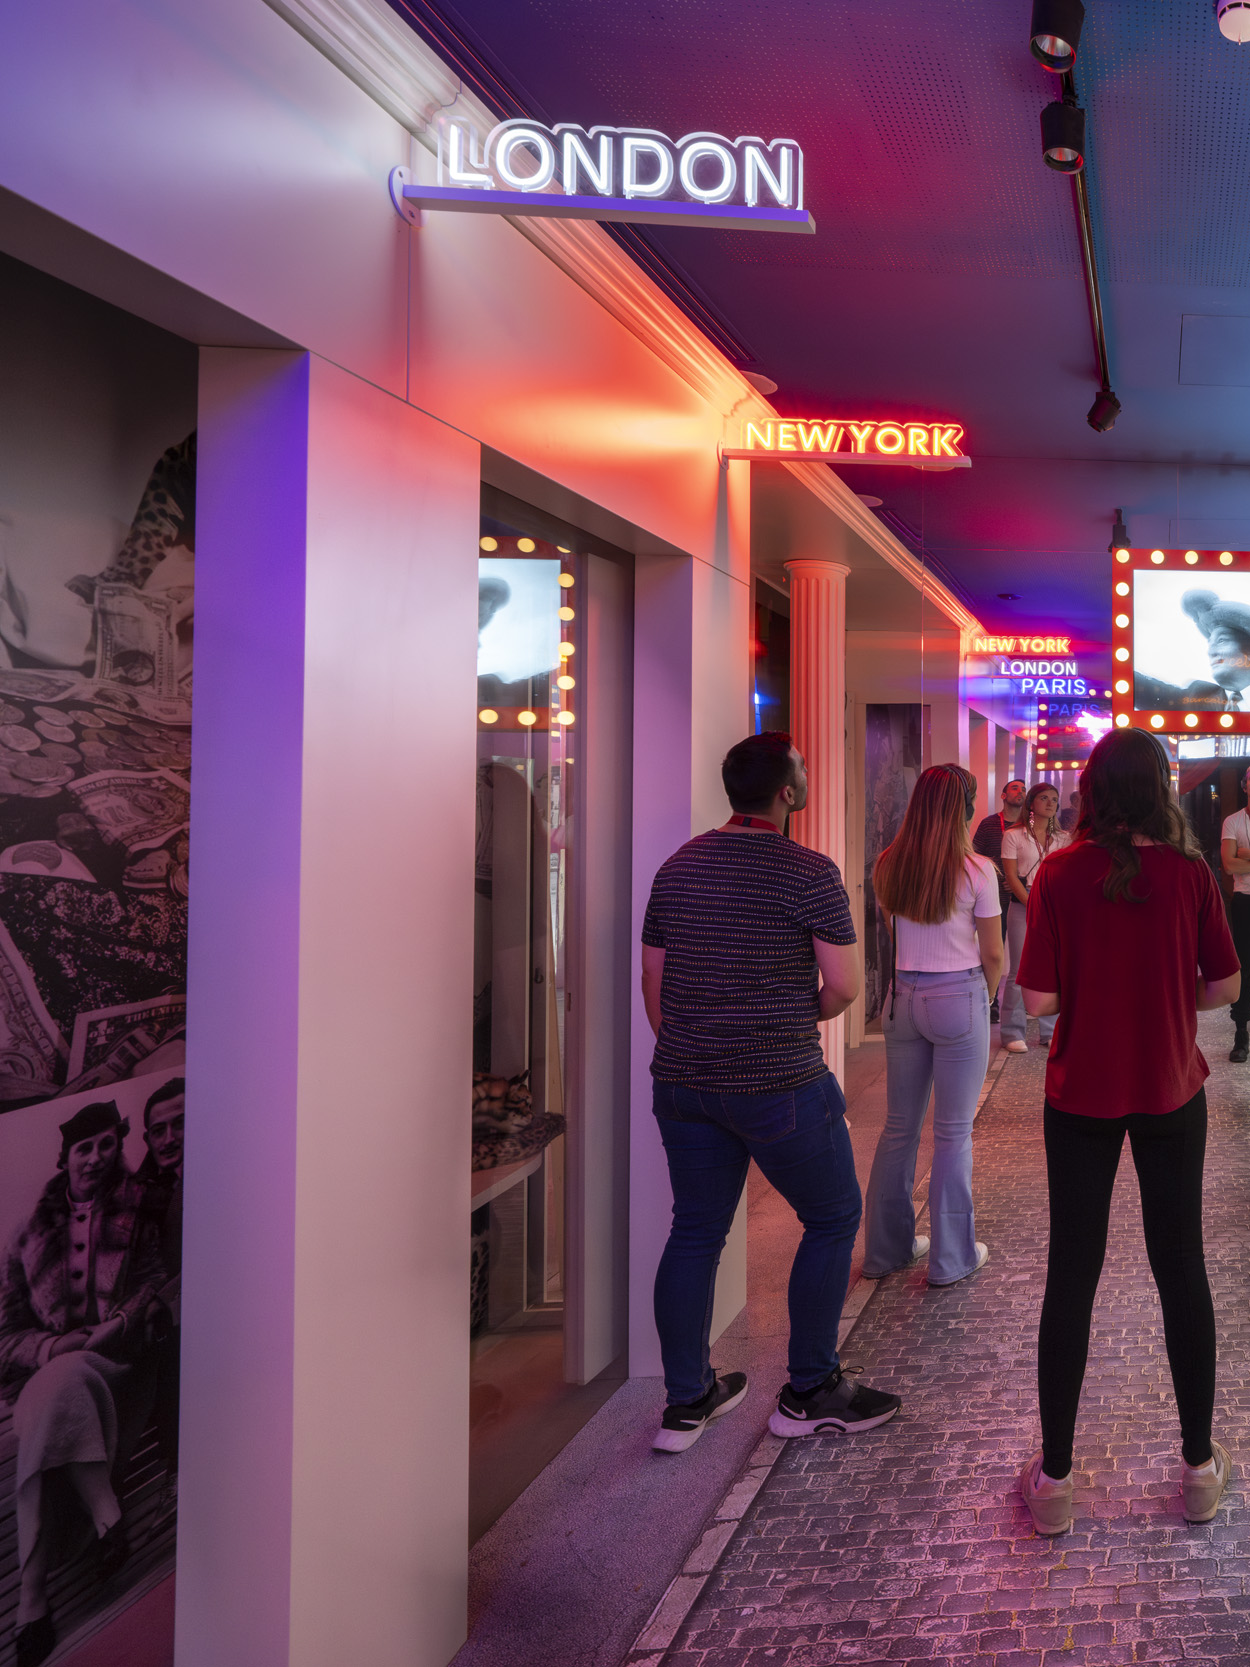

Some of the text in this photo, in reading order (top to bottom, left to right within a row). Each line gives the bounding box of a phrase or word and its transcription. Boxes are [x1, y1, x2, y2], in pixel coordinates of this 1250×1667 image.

[446, 121, 796, 208] LONDON
[746, 420, 958, 457] NEW YORK
[975, 637, 1069, 653] NEW YORK
[1000, 660, 1077, 676] LONDON
[1021, 678, 1086, 695] PARIS
[1048, 703, 1101, 717] PARIS
